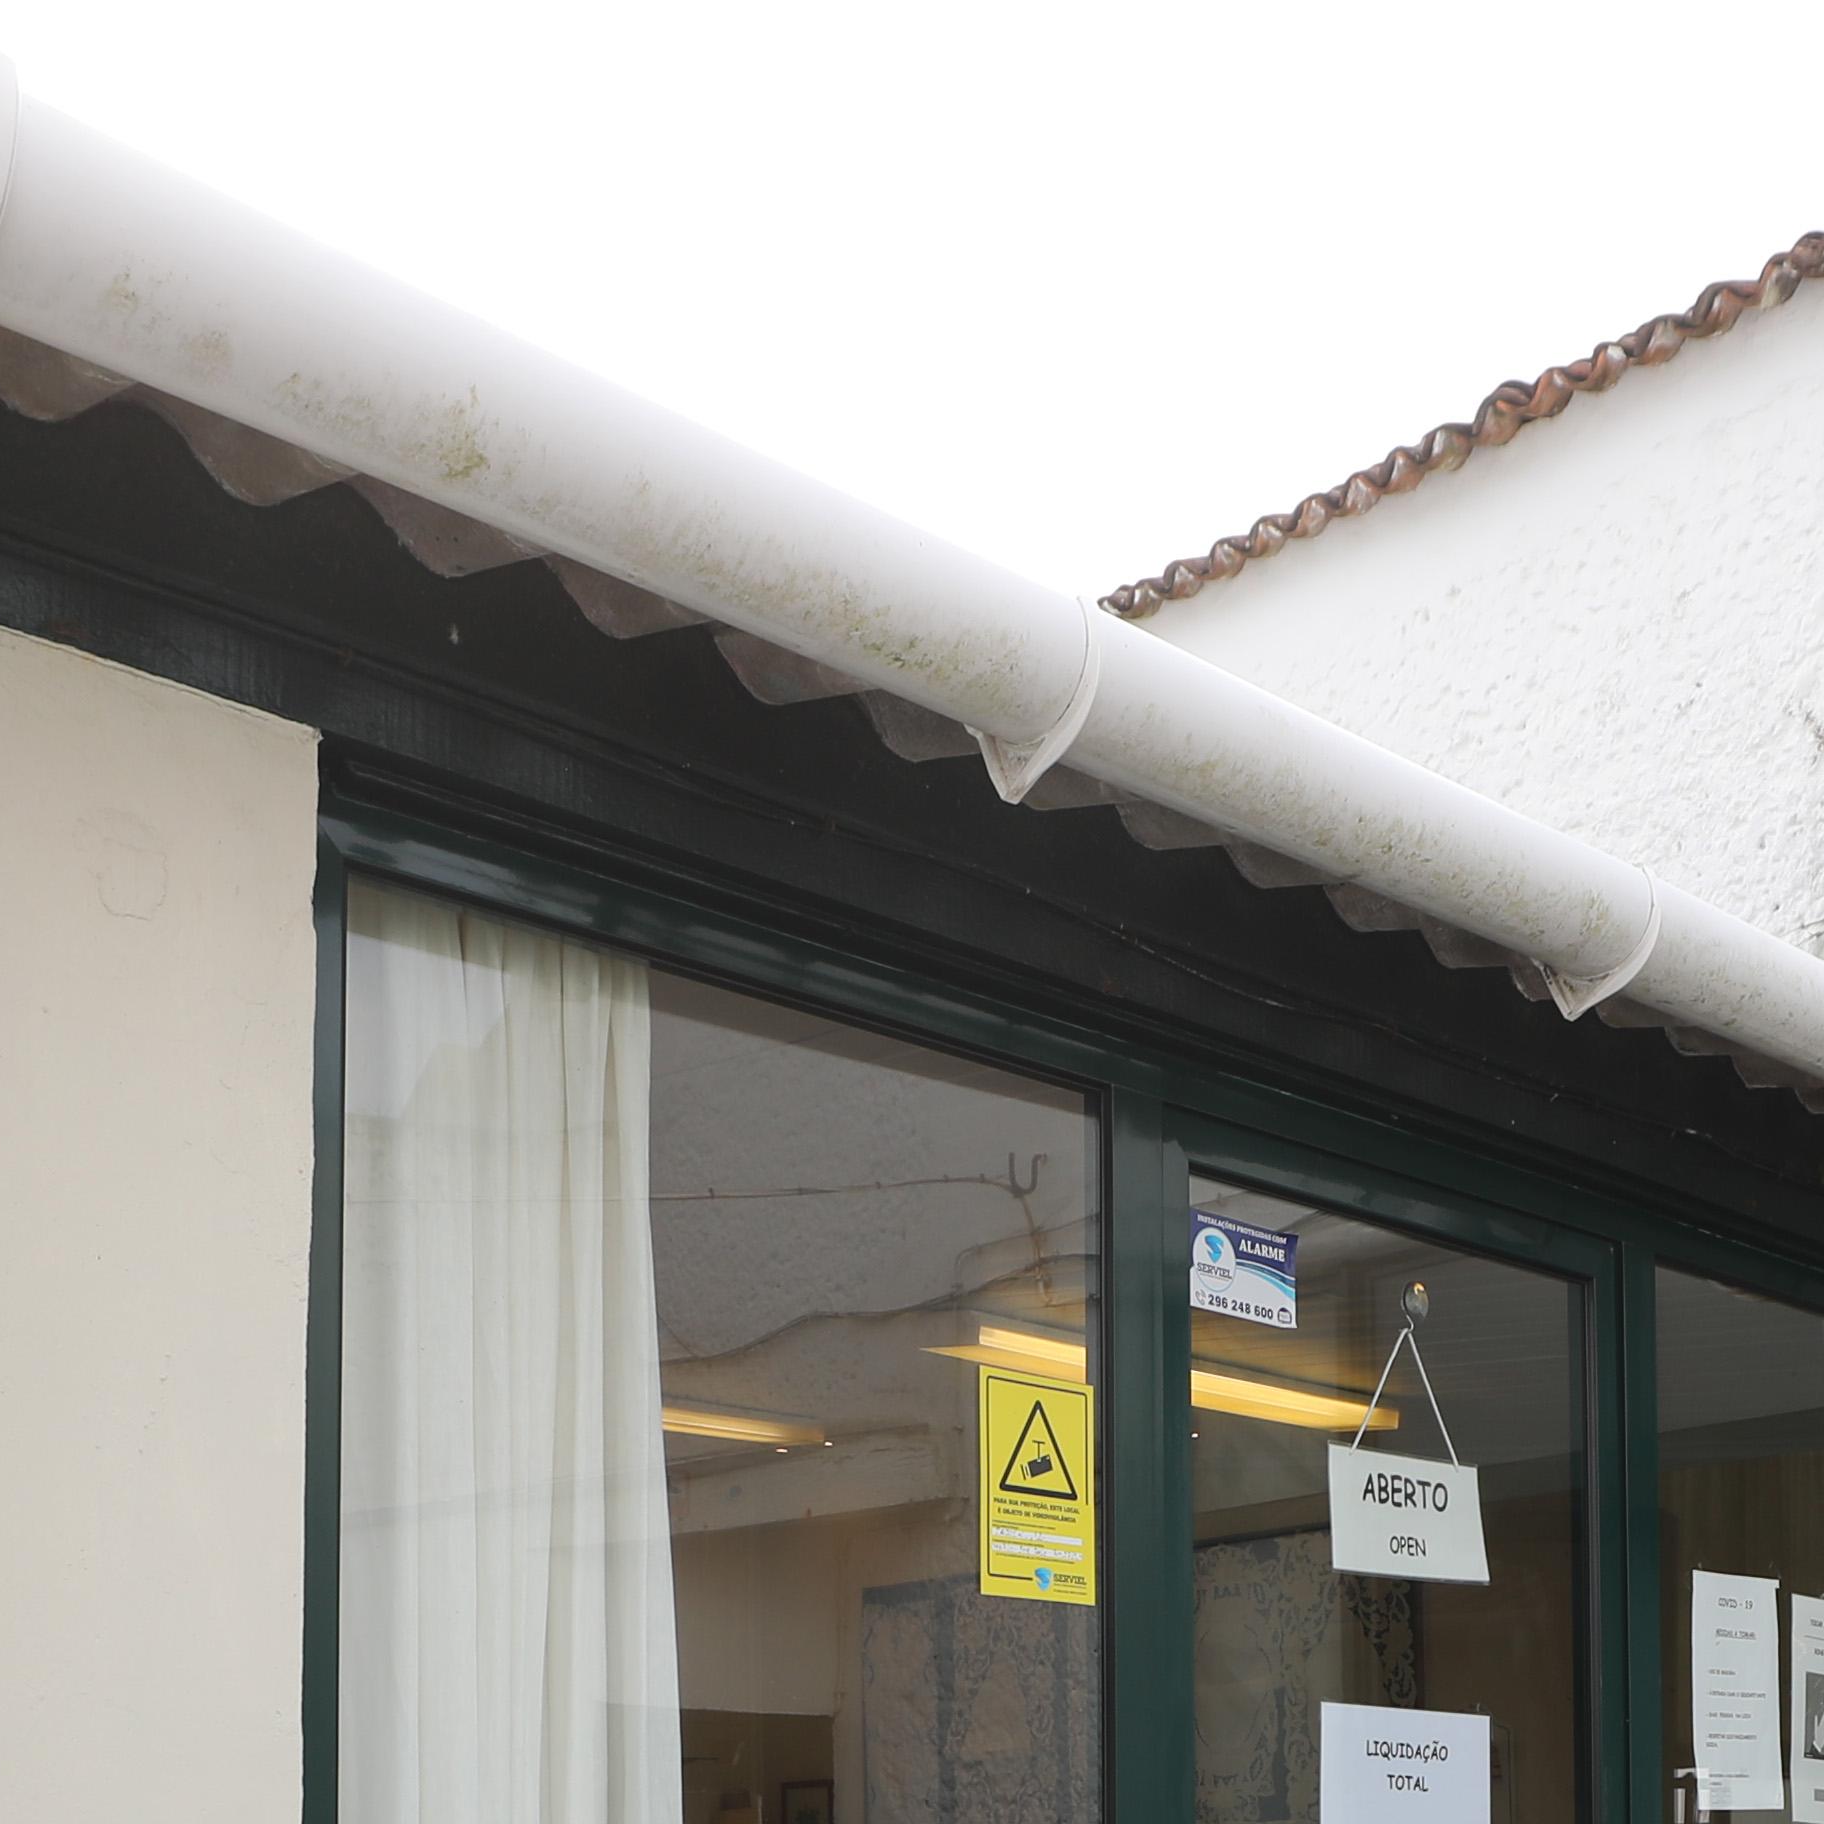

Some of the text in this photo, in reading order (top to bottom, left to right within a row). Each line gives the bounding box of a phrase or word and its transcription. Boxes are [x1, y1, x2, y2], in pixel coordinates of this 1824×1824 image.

[1239, 1239, 1286, 1262] ALARME
[1197, 1263, 1233, 1280] SERVIEL
[1207, 1293, 1274, 1320] 296 248 600
[1362, 1472, 1449, 1513] ABERTO
[1389, 1535, 1427, 1557] OPEN
[1366, 1739, 1449, 1764] LIQUIDAÇÃO
[1387, 1774, 1429, 1793] TOTAL
